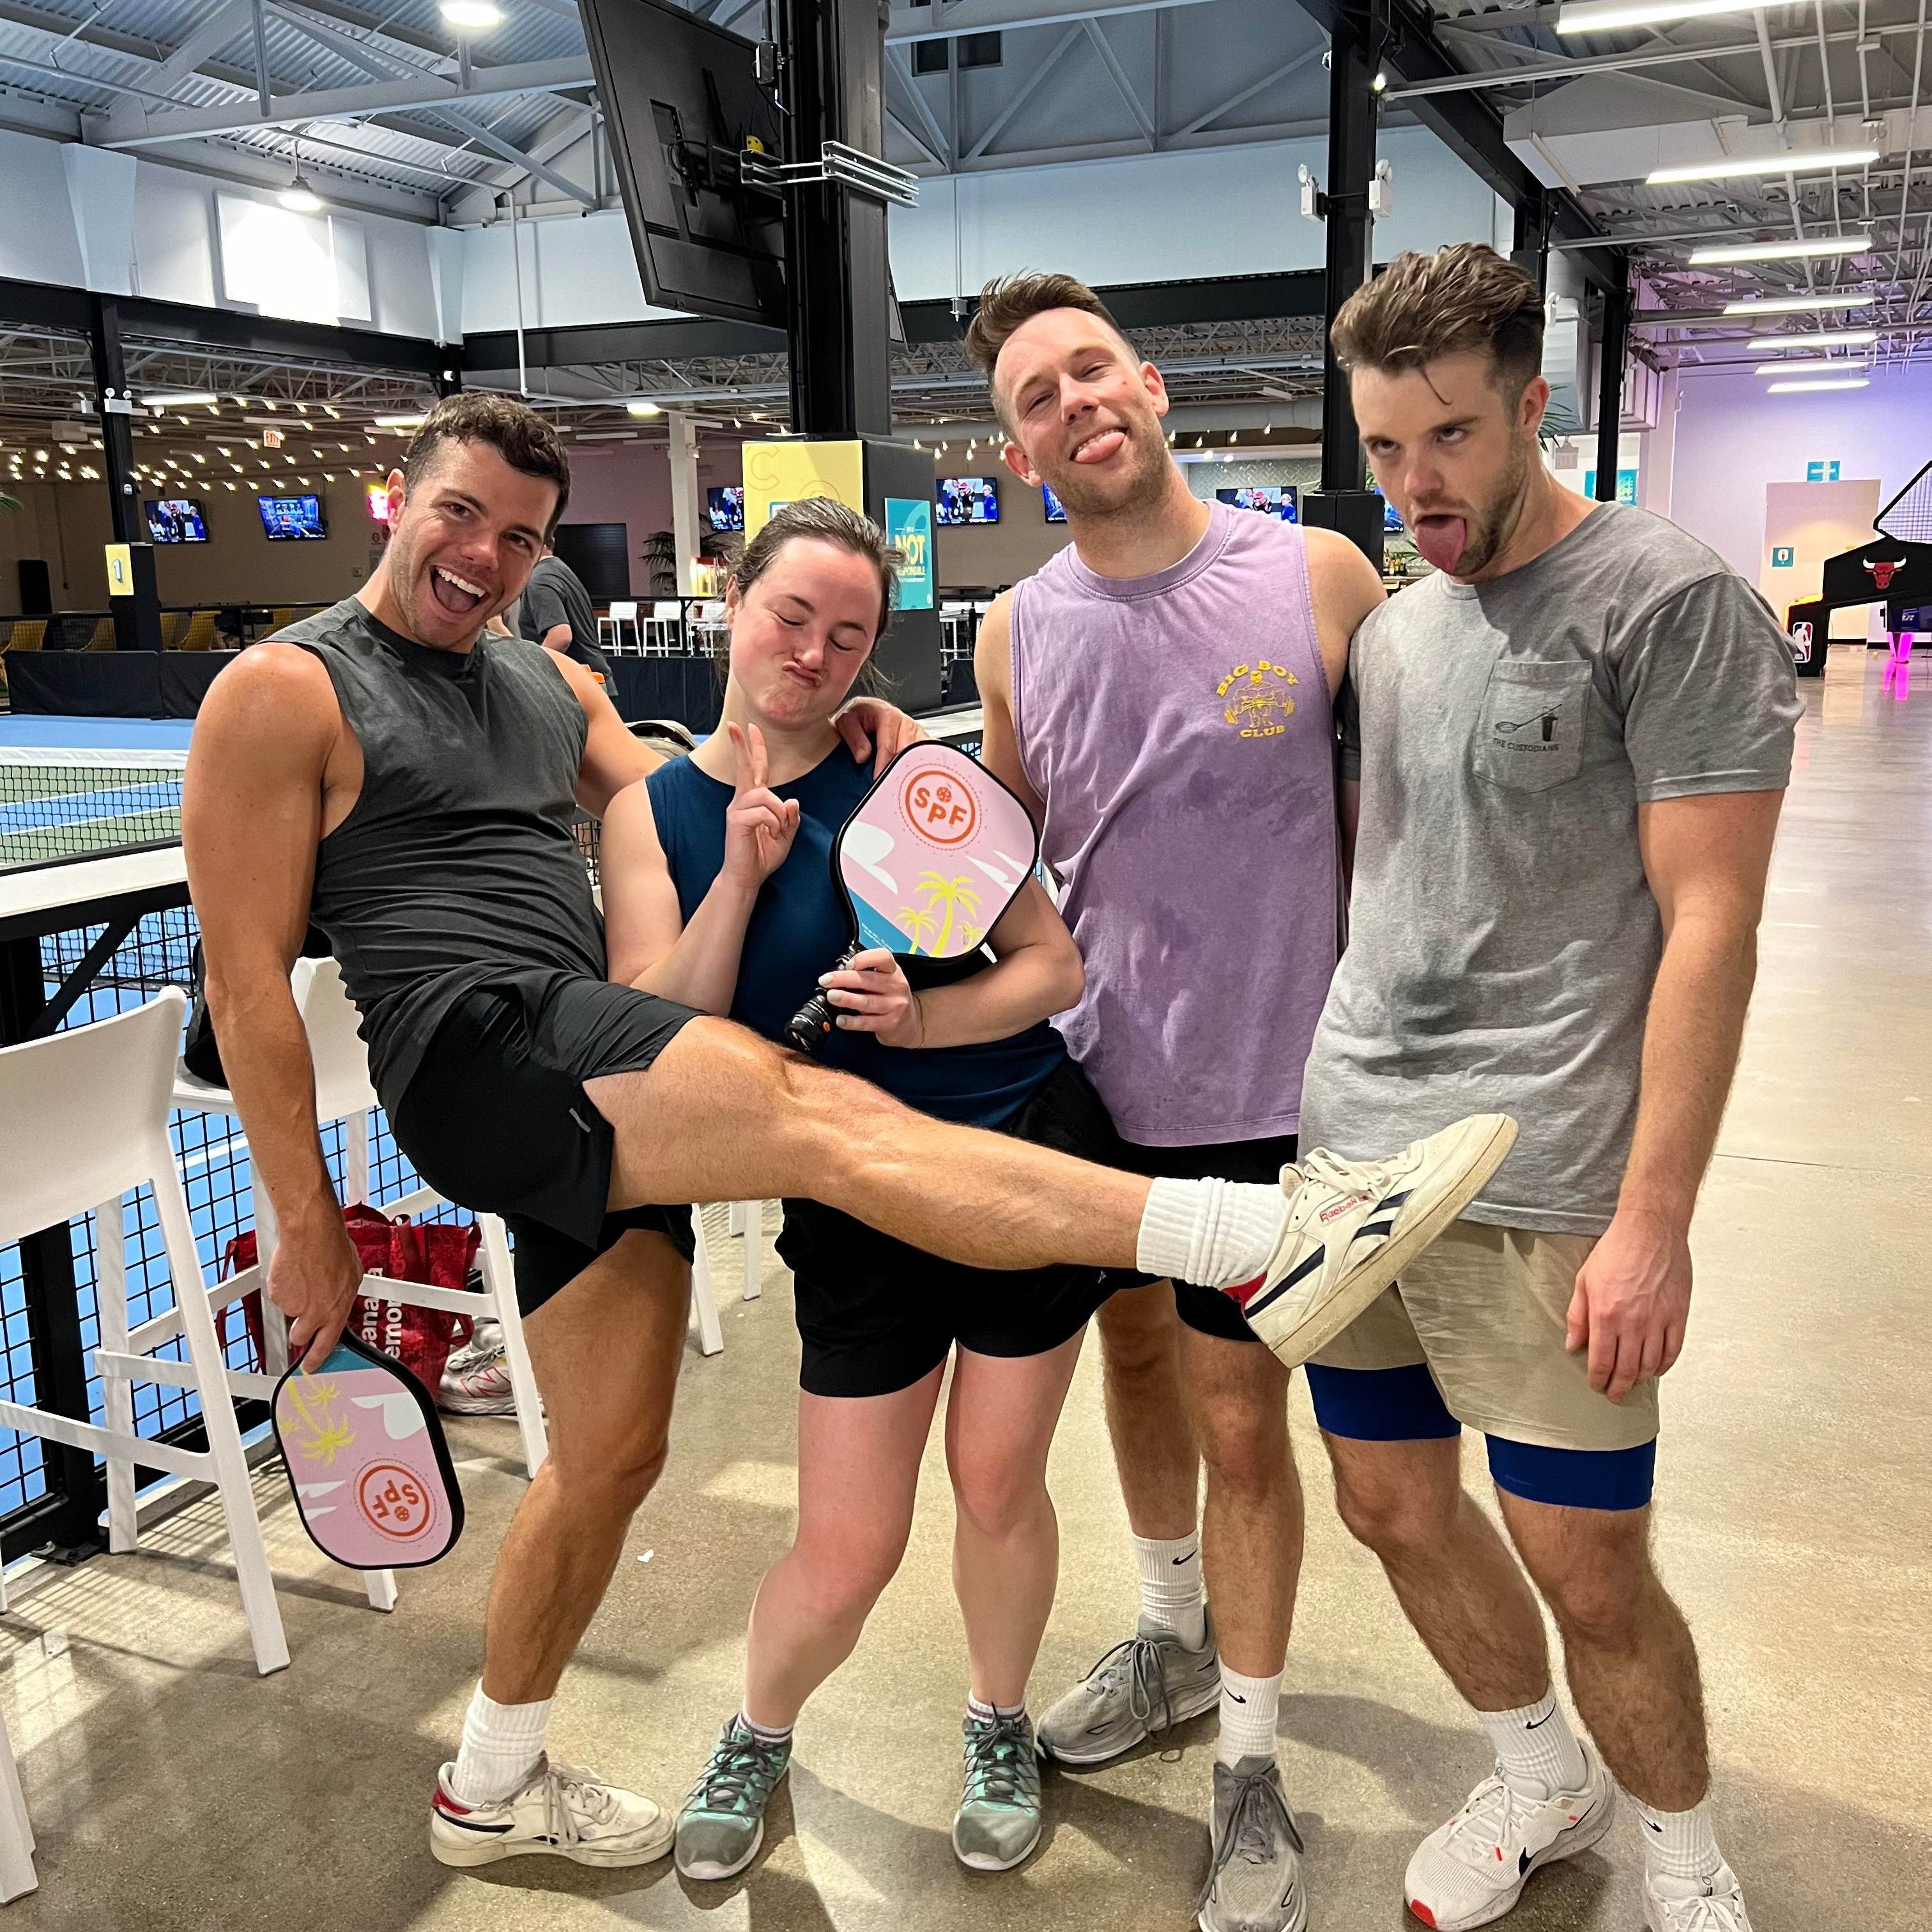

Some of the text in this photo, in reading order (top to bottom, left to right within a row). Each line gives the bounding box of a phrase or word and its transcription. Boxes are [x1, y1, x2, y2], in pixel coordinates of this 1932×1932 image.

[895, 534, 925, 565] NOT
[112, 558, 123, 583] 1
[1239, 725, 1285, 737] CLUB
[1493, 737, 1560, 752] THE CUSTODIANS
[914, 787, 967, 825] SPF
[1319, 1198, 1358, 1222] Reebok
[373, 1480, 420, 1519] SPF
